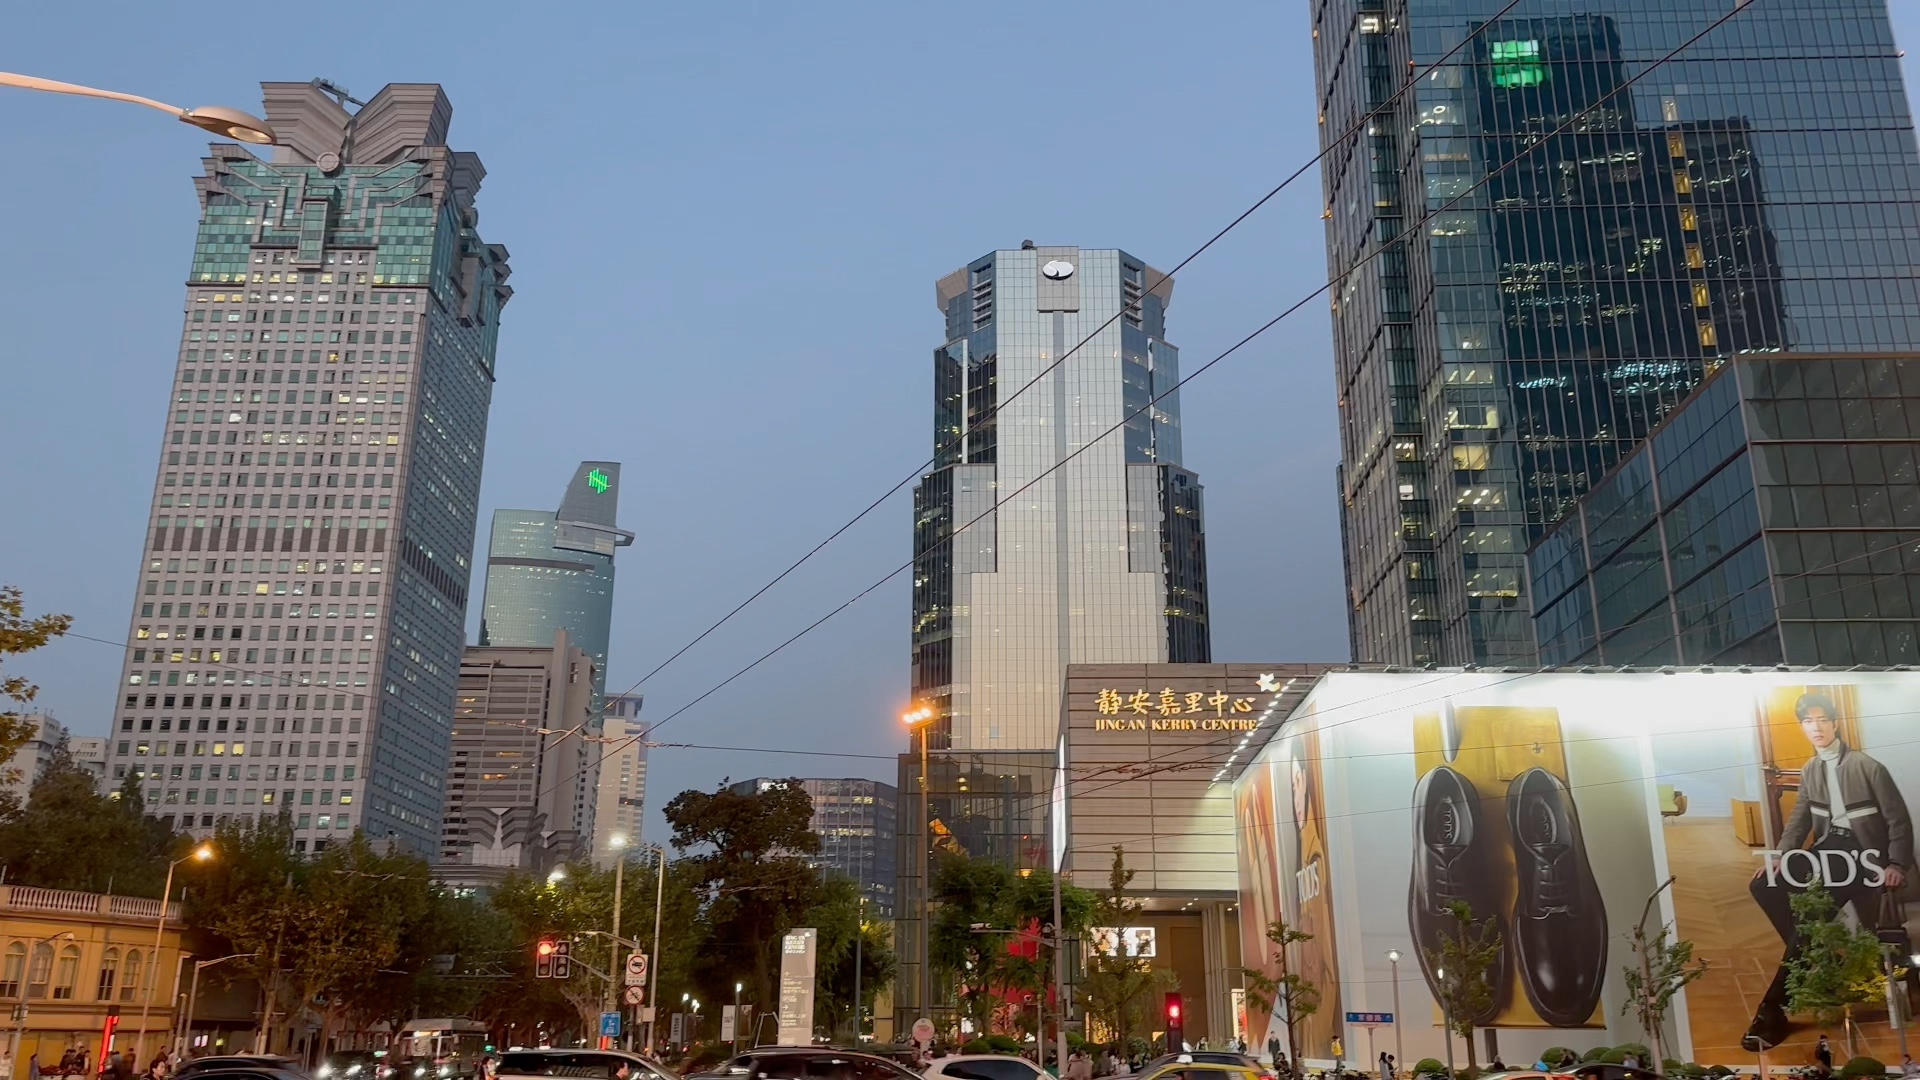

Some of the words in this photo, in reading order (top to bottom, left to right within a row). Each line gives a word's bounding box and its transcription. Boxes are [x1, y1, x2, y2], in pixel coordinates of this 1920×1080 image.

[1094, 686, 1256, 717] 静安嘉里中心
[1151, 719, 1199, 731] KERRY
[1202, 719, 1257, 731] CENTRE
[1752, 848, 1886, 888] TOD'S
